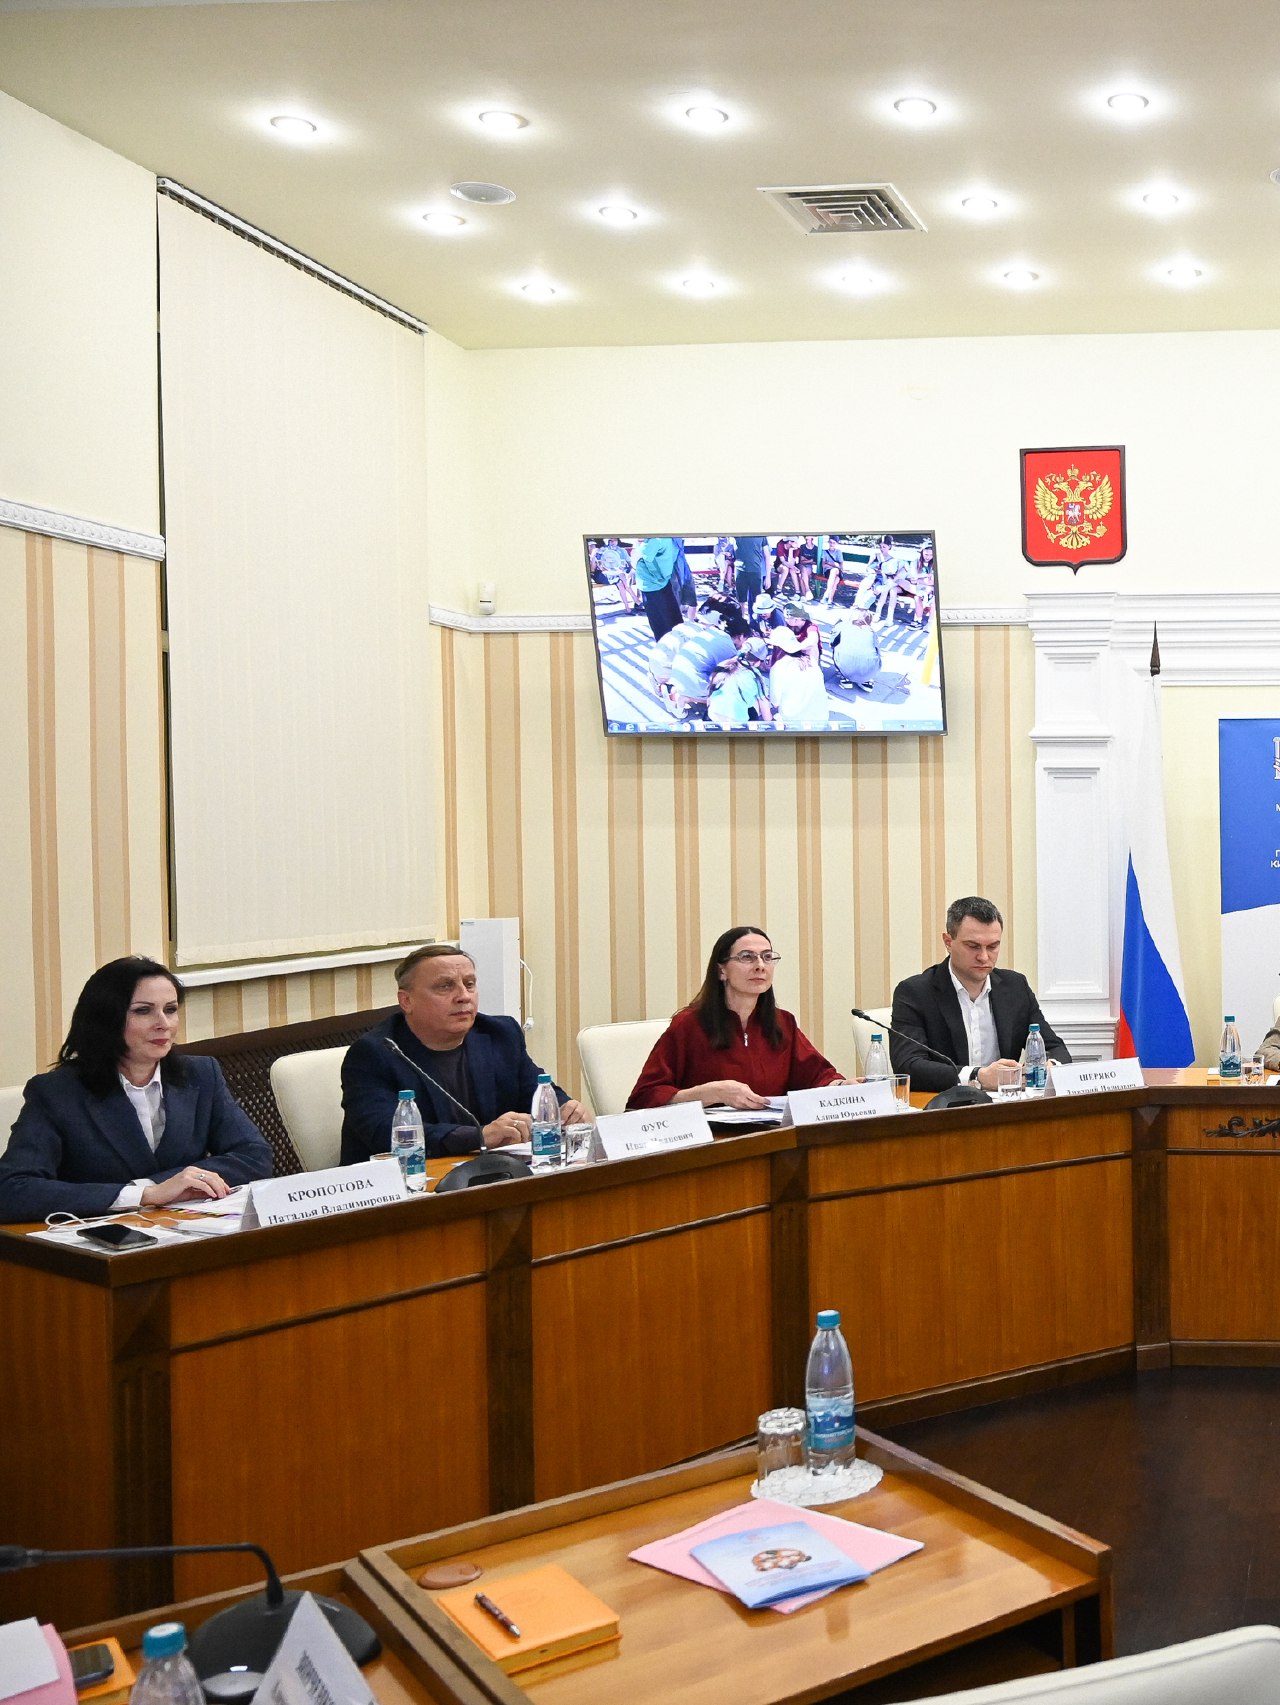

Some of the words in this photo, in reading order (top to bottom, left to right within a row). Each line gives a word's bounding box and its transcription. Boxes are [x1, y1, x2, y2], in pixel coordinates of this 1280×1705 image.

[819, 1096, 866, 1108] КАДКИНА
[642, 1120, 670, 1132] ФУРС
[288, 1178, 374, 1202] КРОПОТОВА
[268, 1208, 318, 1225] Наталья
[320, 1192, 401, 1214] Владимировна
